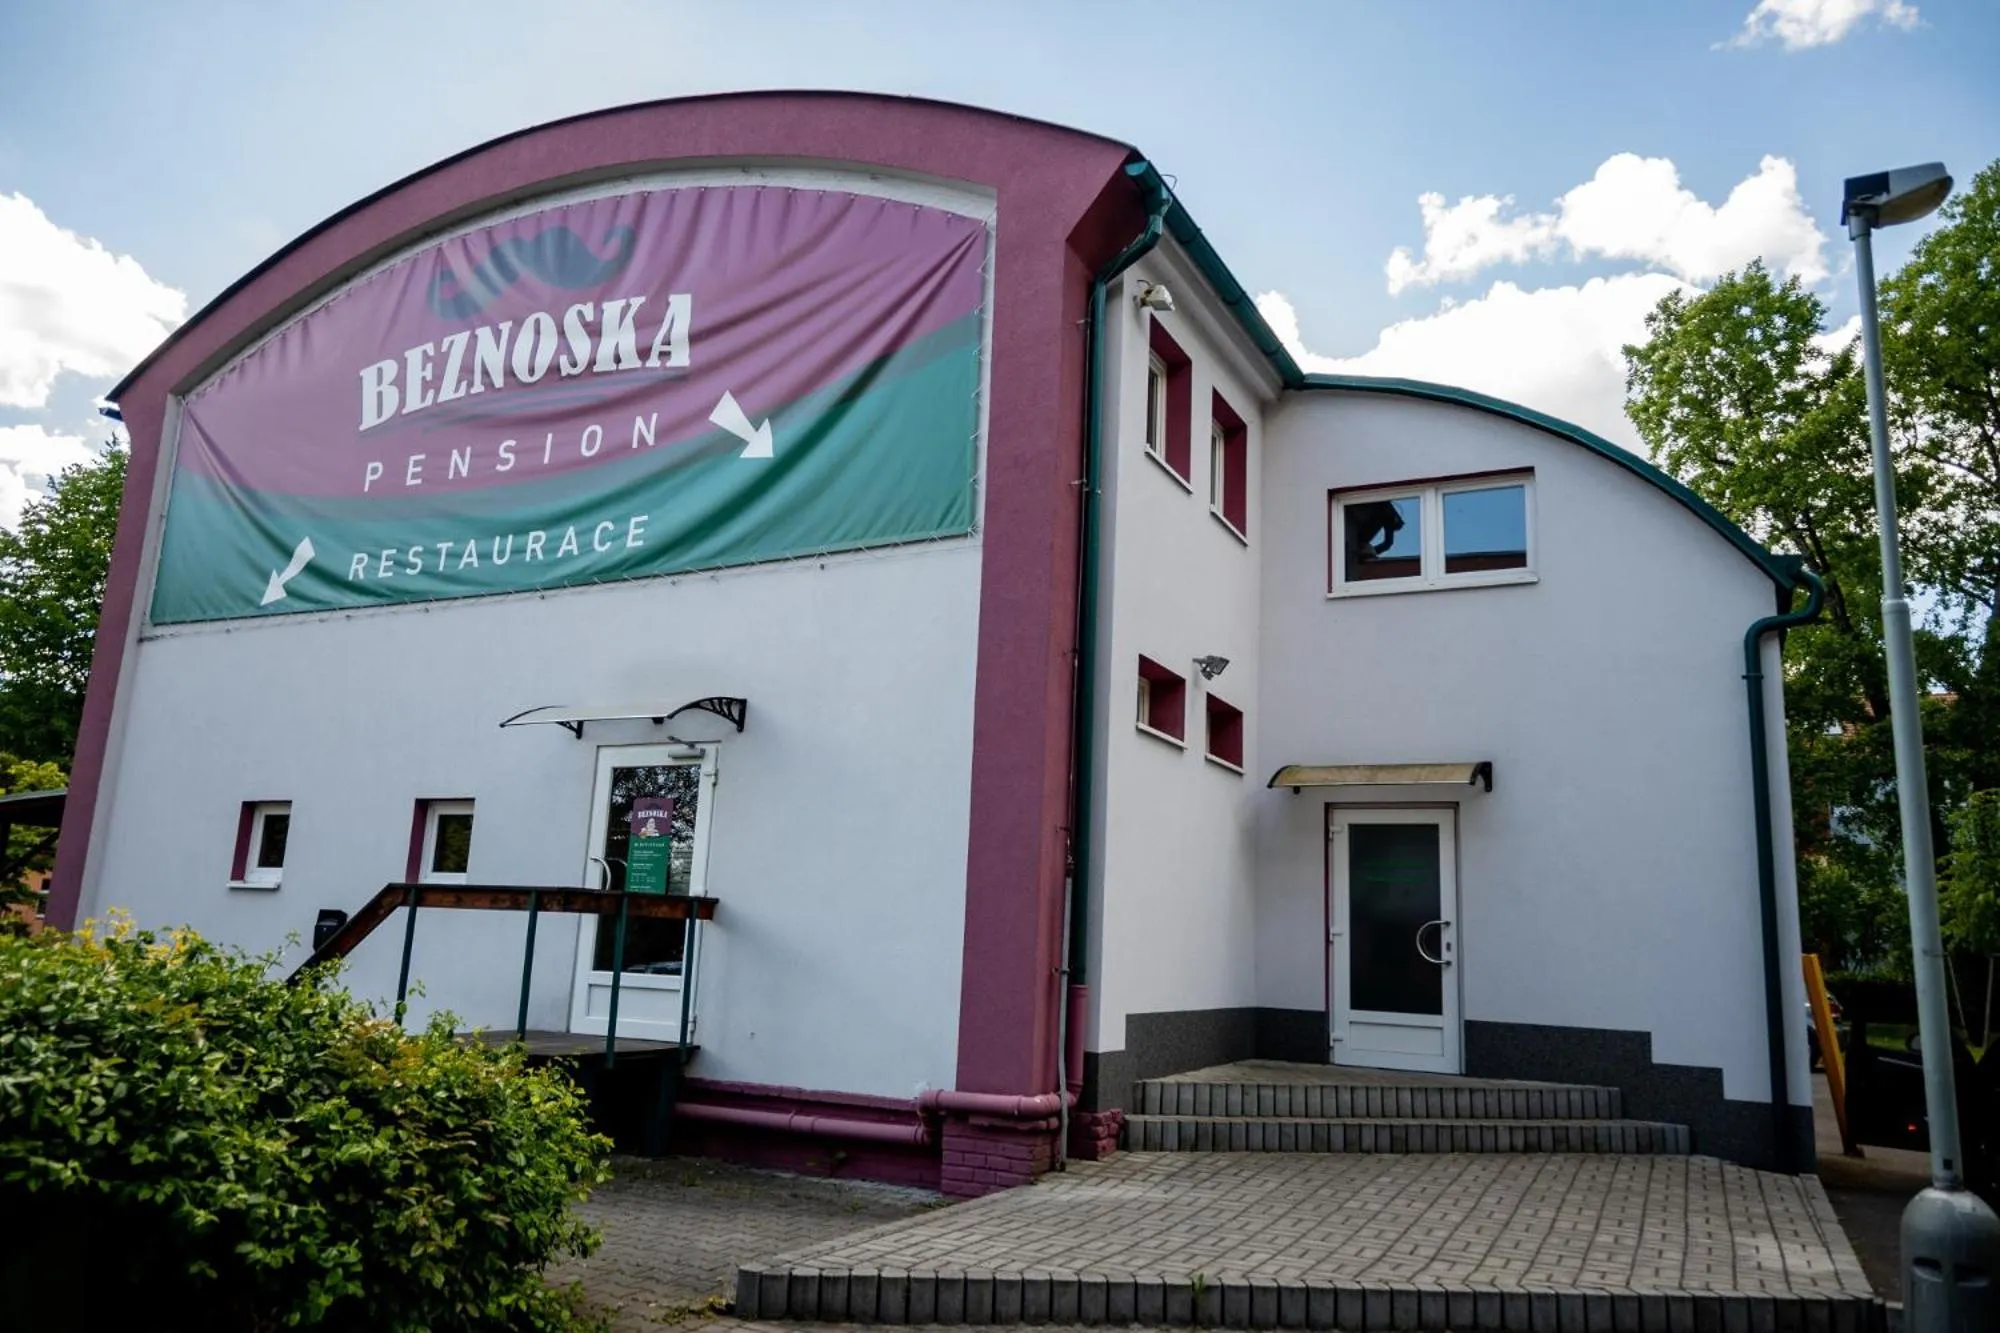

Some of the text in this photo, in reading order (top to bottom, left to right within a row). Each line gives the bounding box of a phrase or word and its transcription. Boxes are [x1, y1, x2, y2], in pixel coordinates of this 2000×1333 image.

[359, 294, 692, 431] BEZNOSKA
[364, 413, 658, 492] PENSION
[349, 516, 648, 580] RESTAURACE
